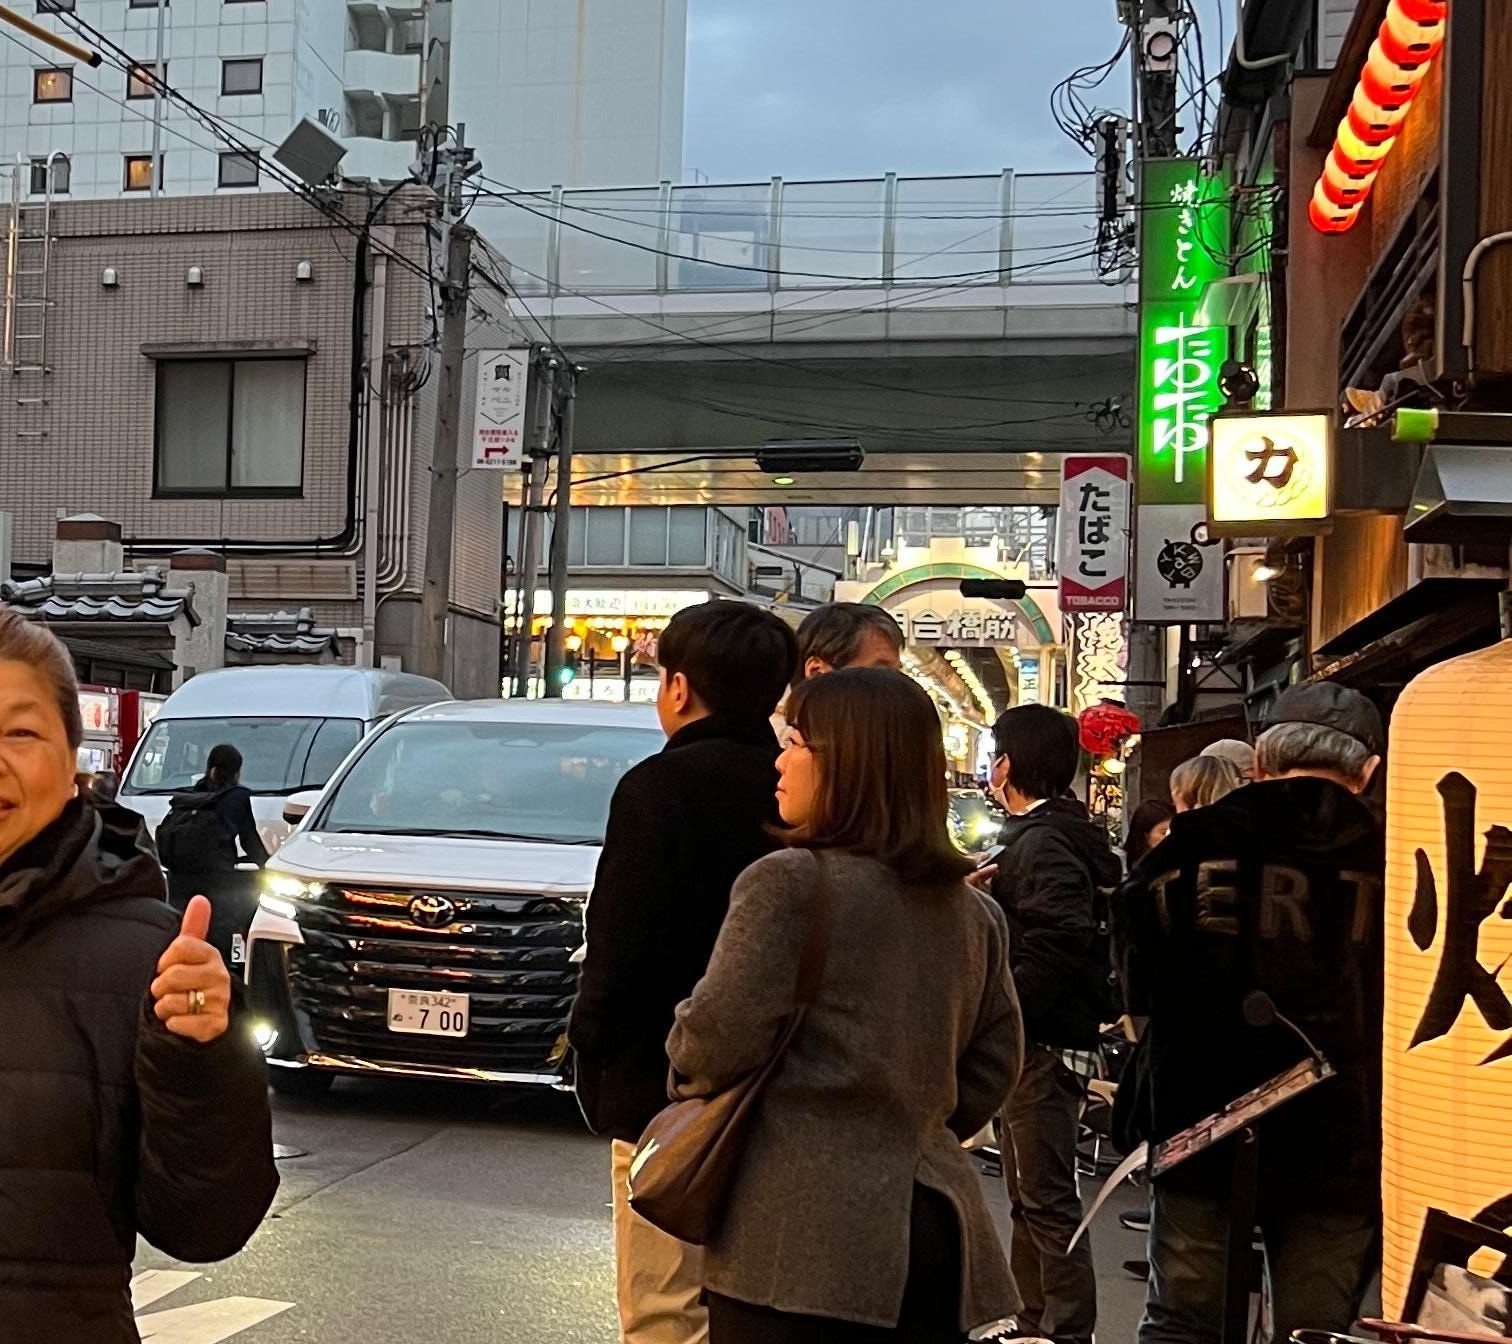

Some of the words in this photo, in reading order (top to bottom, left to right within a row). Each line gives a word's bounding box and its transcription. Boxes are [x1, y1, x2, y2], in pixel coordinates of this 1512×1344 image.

[1079, 483, 1111, 577] たばこ
[1065, 595, 1121, 606] TOBACCO
[431, 997, 451, 1008] 342
